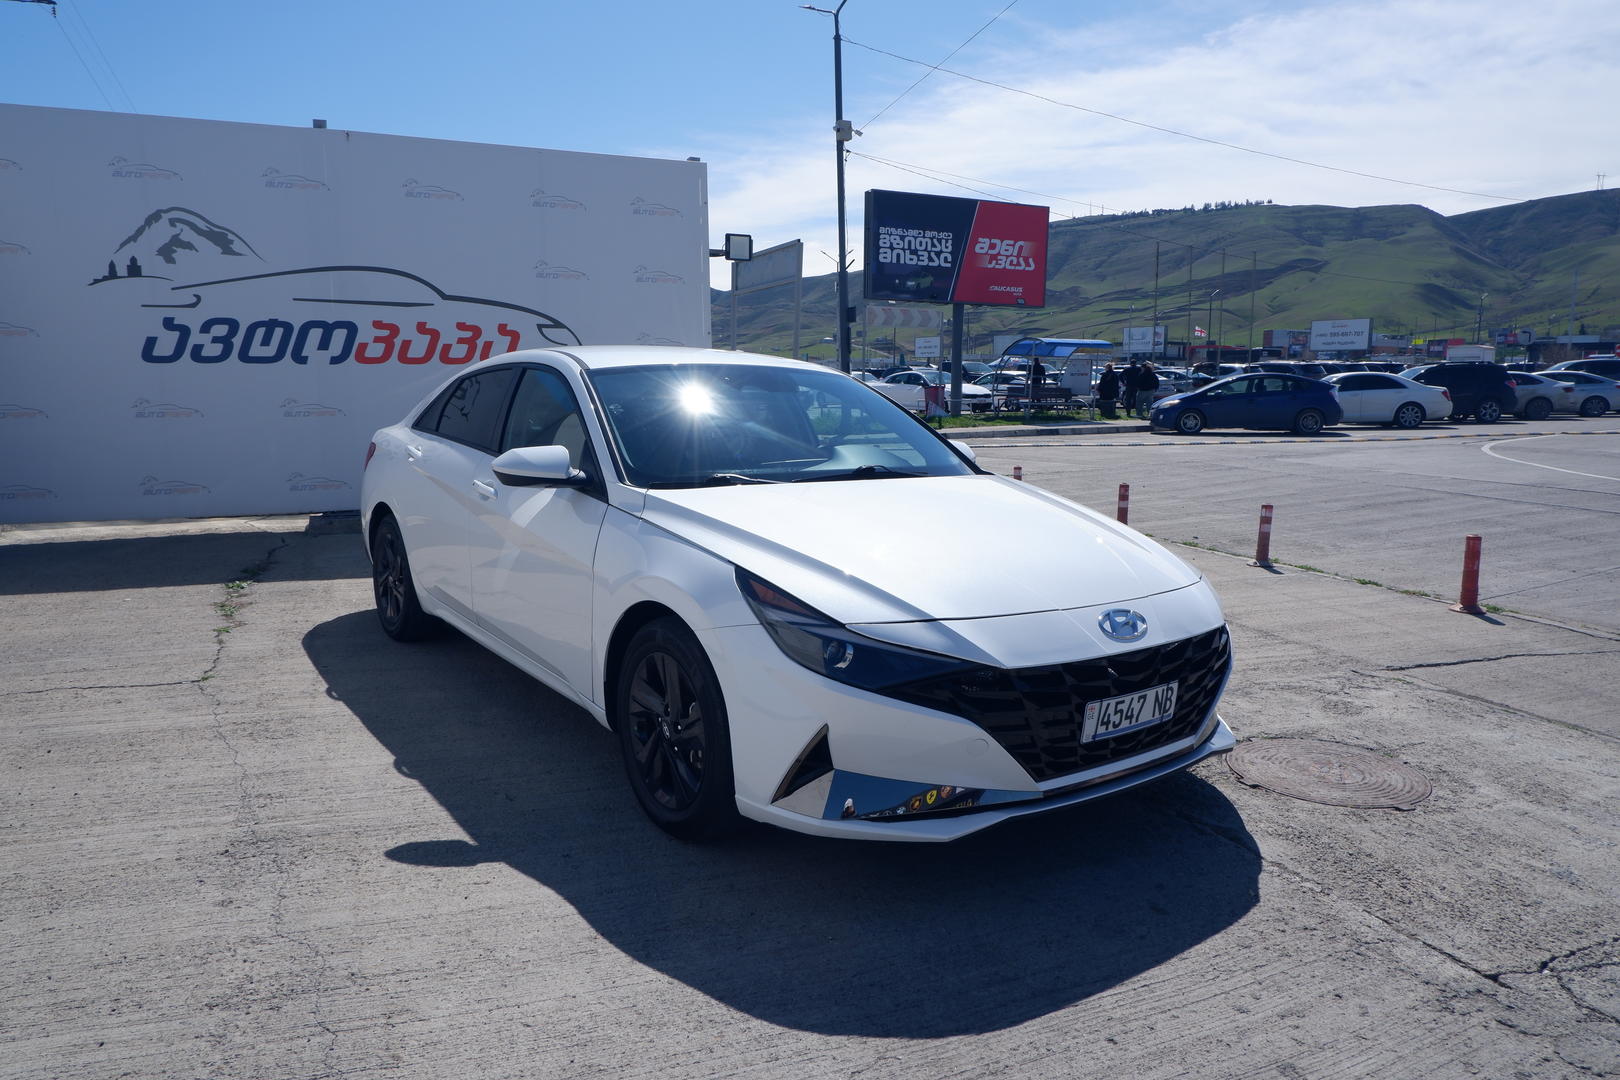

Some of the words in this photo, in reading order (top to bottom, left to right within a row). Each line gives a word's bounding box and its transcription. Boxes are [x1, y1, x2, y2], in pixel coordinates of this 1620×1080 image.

[879, 234, 952, 252] გზითაც
[879, 248, 952, 267] მიხვალ
[1101, 693, 1147, 731] 4547
[1152, 686, 1174, 718] NB
